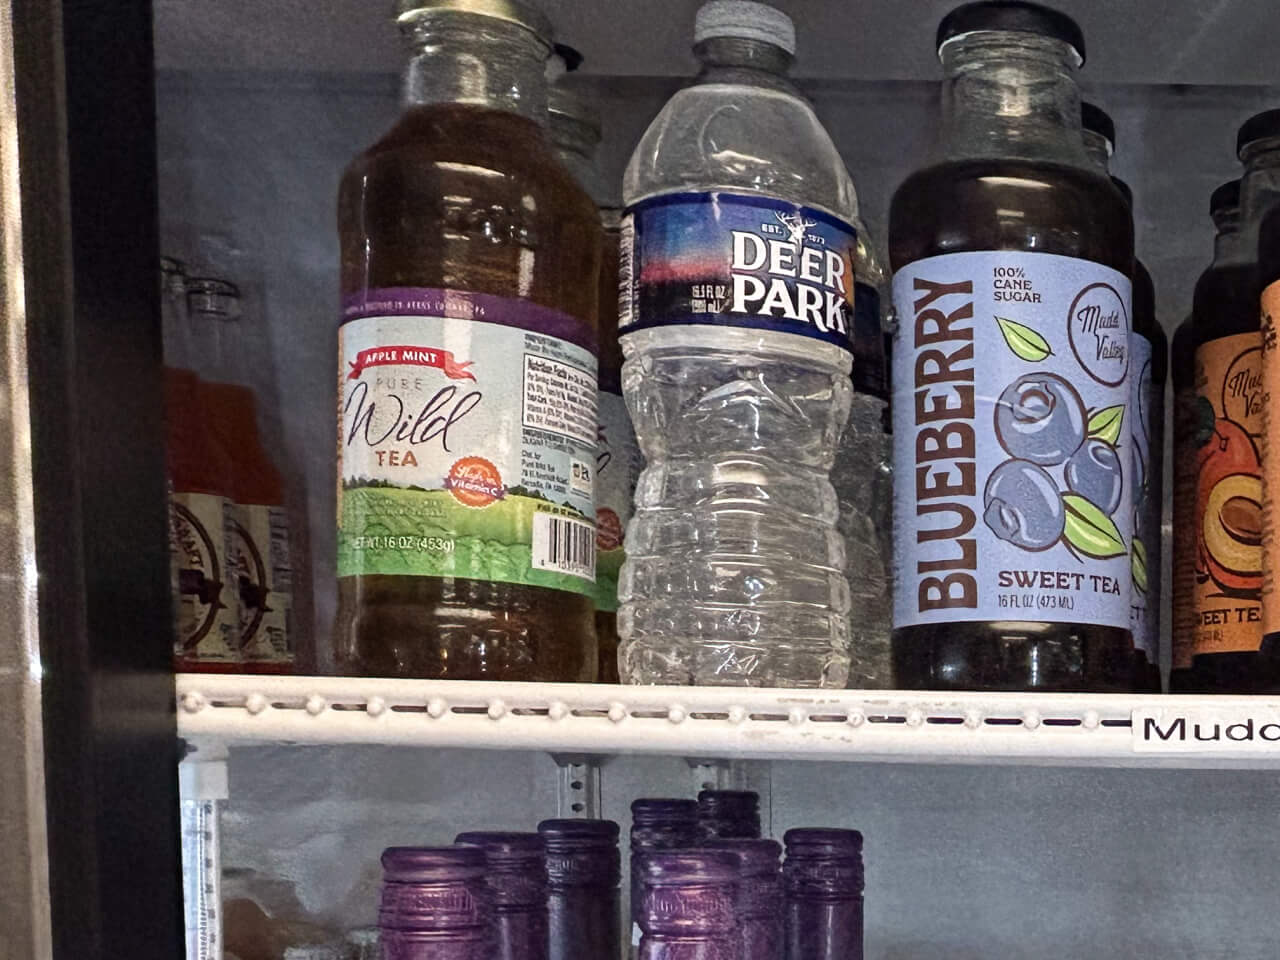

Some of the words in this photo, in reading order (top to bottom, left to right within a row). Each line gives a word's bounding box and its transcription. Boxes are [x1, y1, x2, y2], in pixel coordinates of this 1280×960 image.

[730, 231, 845, 293] DEER
[993, 266, 1026, 278] 100%
[993, 279, 1033, 291] CANE
[730, 273, 847, 334] PARK
[993, 291, 1042, 304] SUGAR
[366, 351, 397, 364] APPLE
[402, 350, 437, 363] MINT
[344, 381, 483, 452] Wild
[913, 277, 978, 613] BLUEBERRY
[375, 450, 418, 467] TEA
[398, 536, 413, 549] OZ
[416, 536, 455, 553] (453g)
[998, 570, 1085, 590] SWEET
[1089, 574, 1121, 596] TEA
[1010, 594, 1020, 608] FL
[1200, 608, 1232, 625] EET
[1235, 607, 1260, 622] TE
